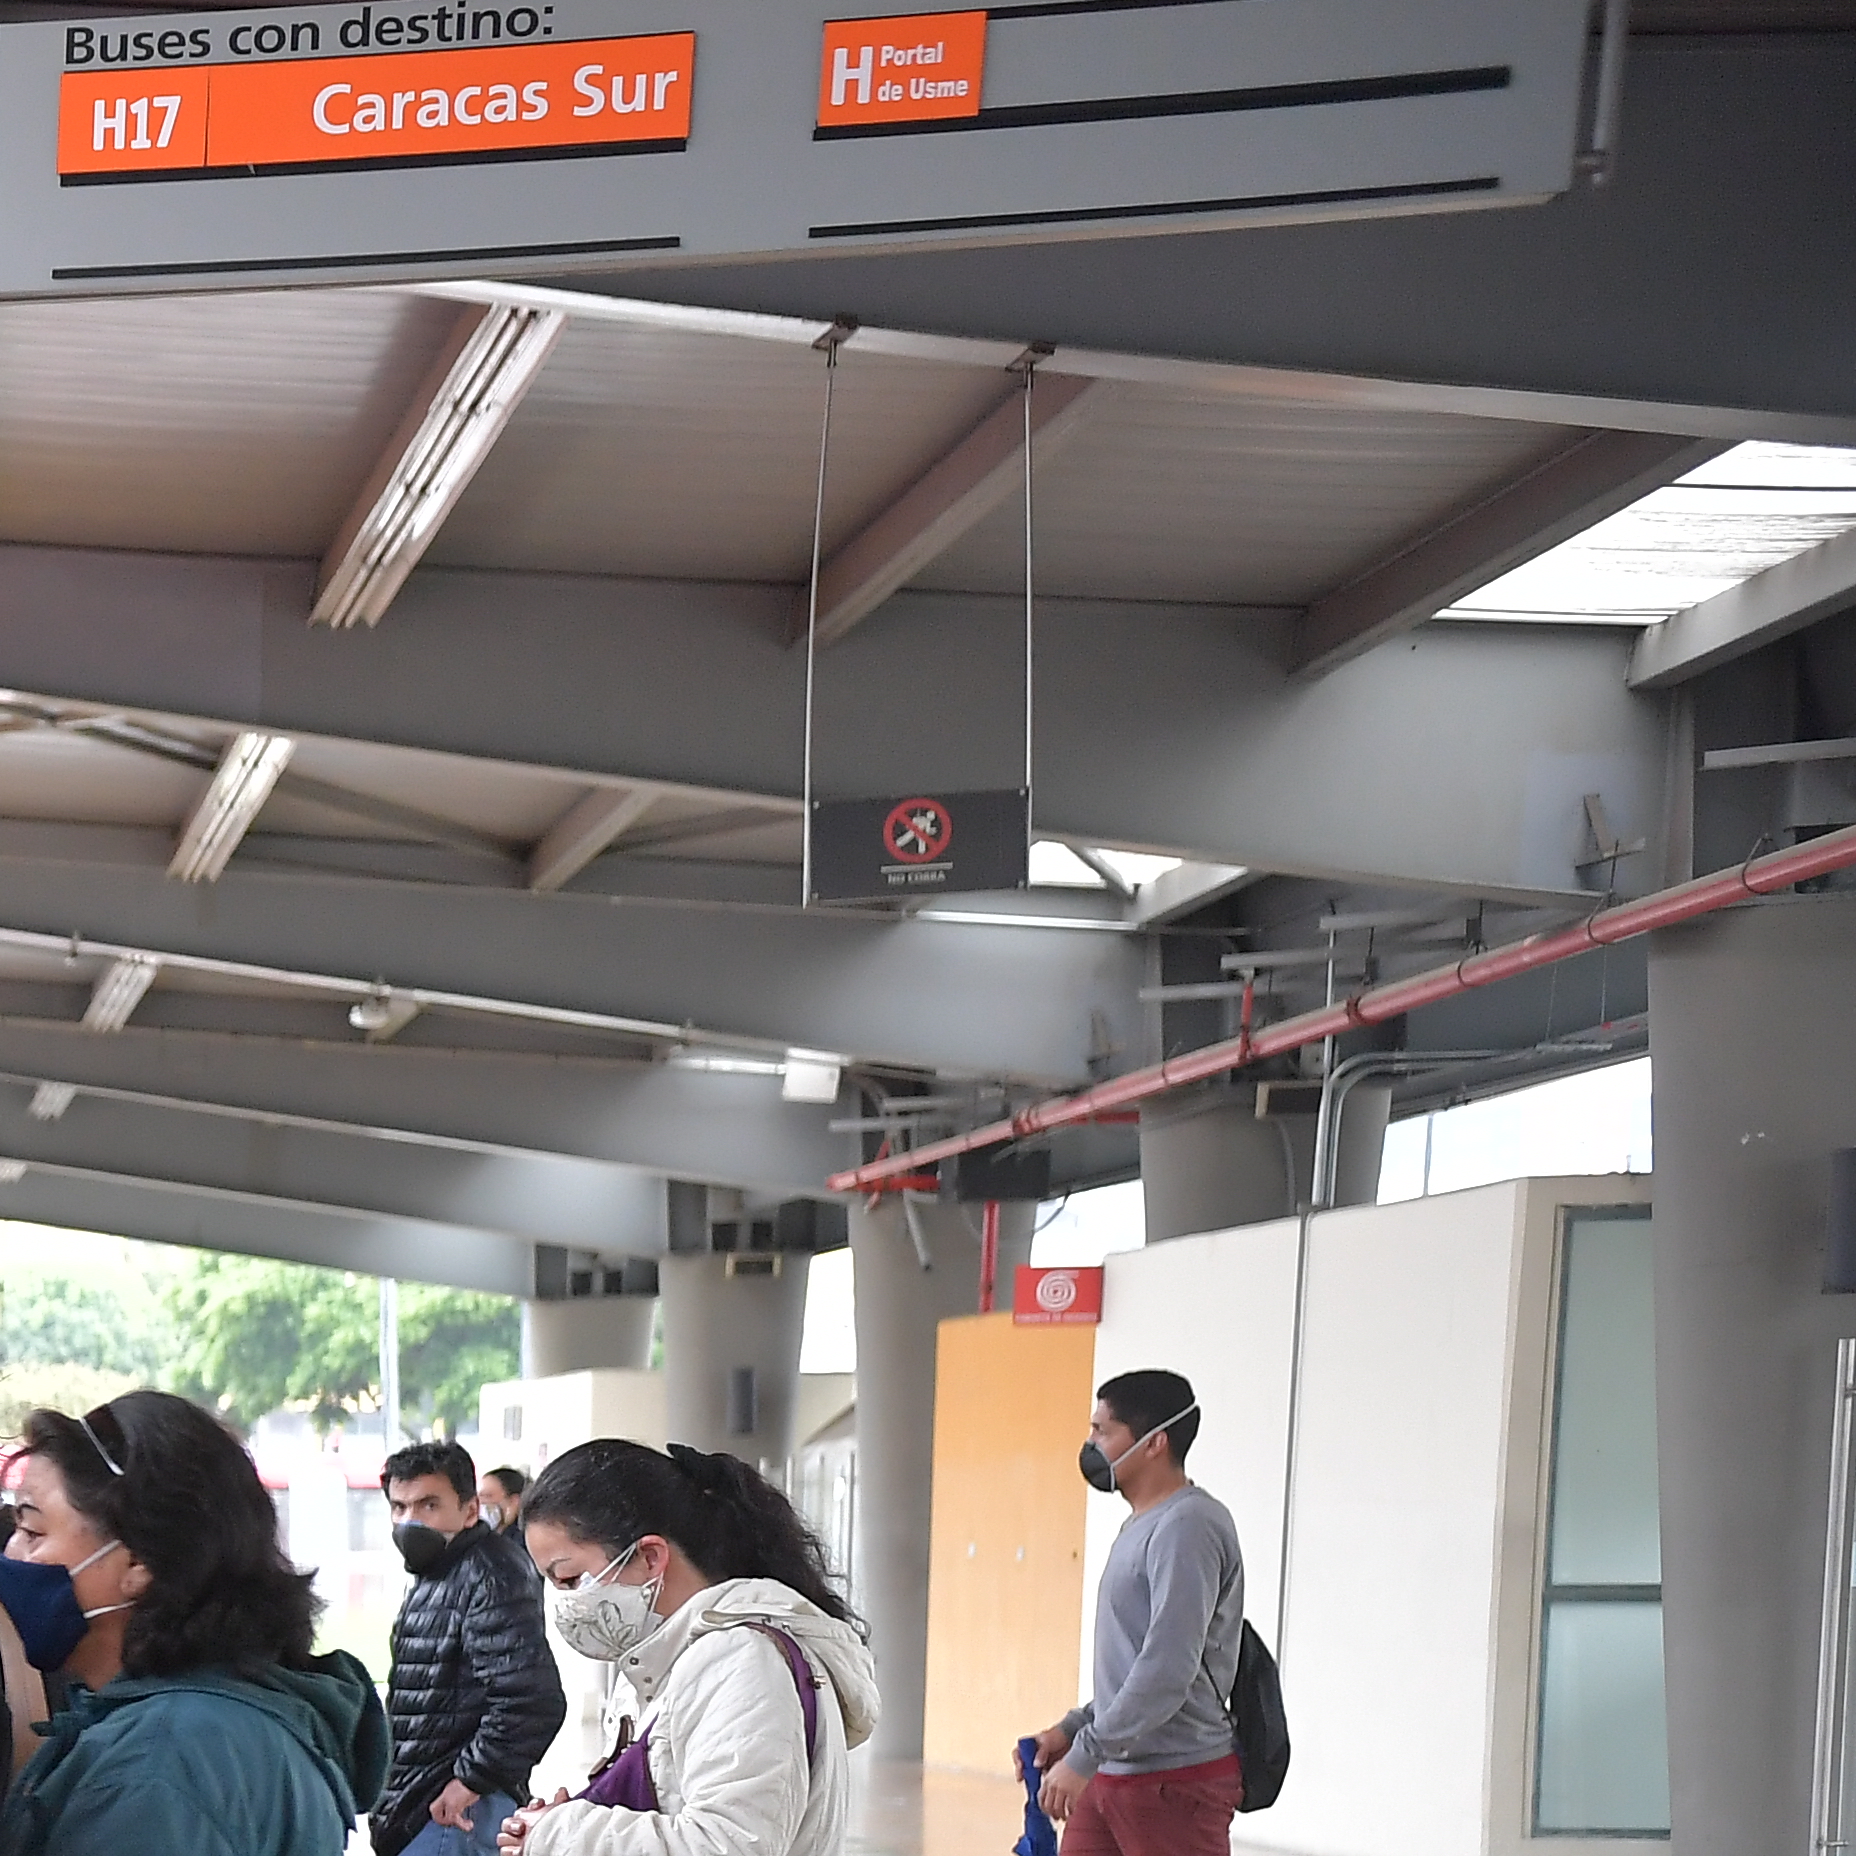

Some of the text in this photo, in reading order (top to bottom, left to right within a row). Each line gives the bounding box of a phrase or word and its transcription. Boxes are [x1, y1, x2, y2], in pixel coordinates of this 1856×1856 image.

[65, 1, 555, 65] Buses con destino:
[880, 41, 944, 67] Portal
[312, 64, 678, 135] Caracas Sur
[830, 45, 874, 106] H
[877, 77, 969, 102] de Usme
[92, 95, 182, 151] H17
